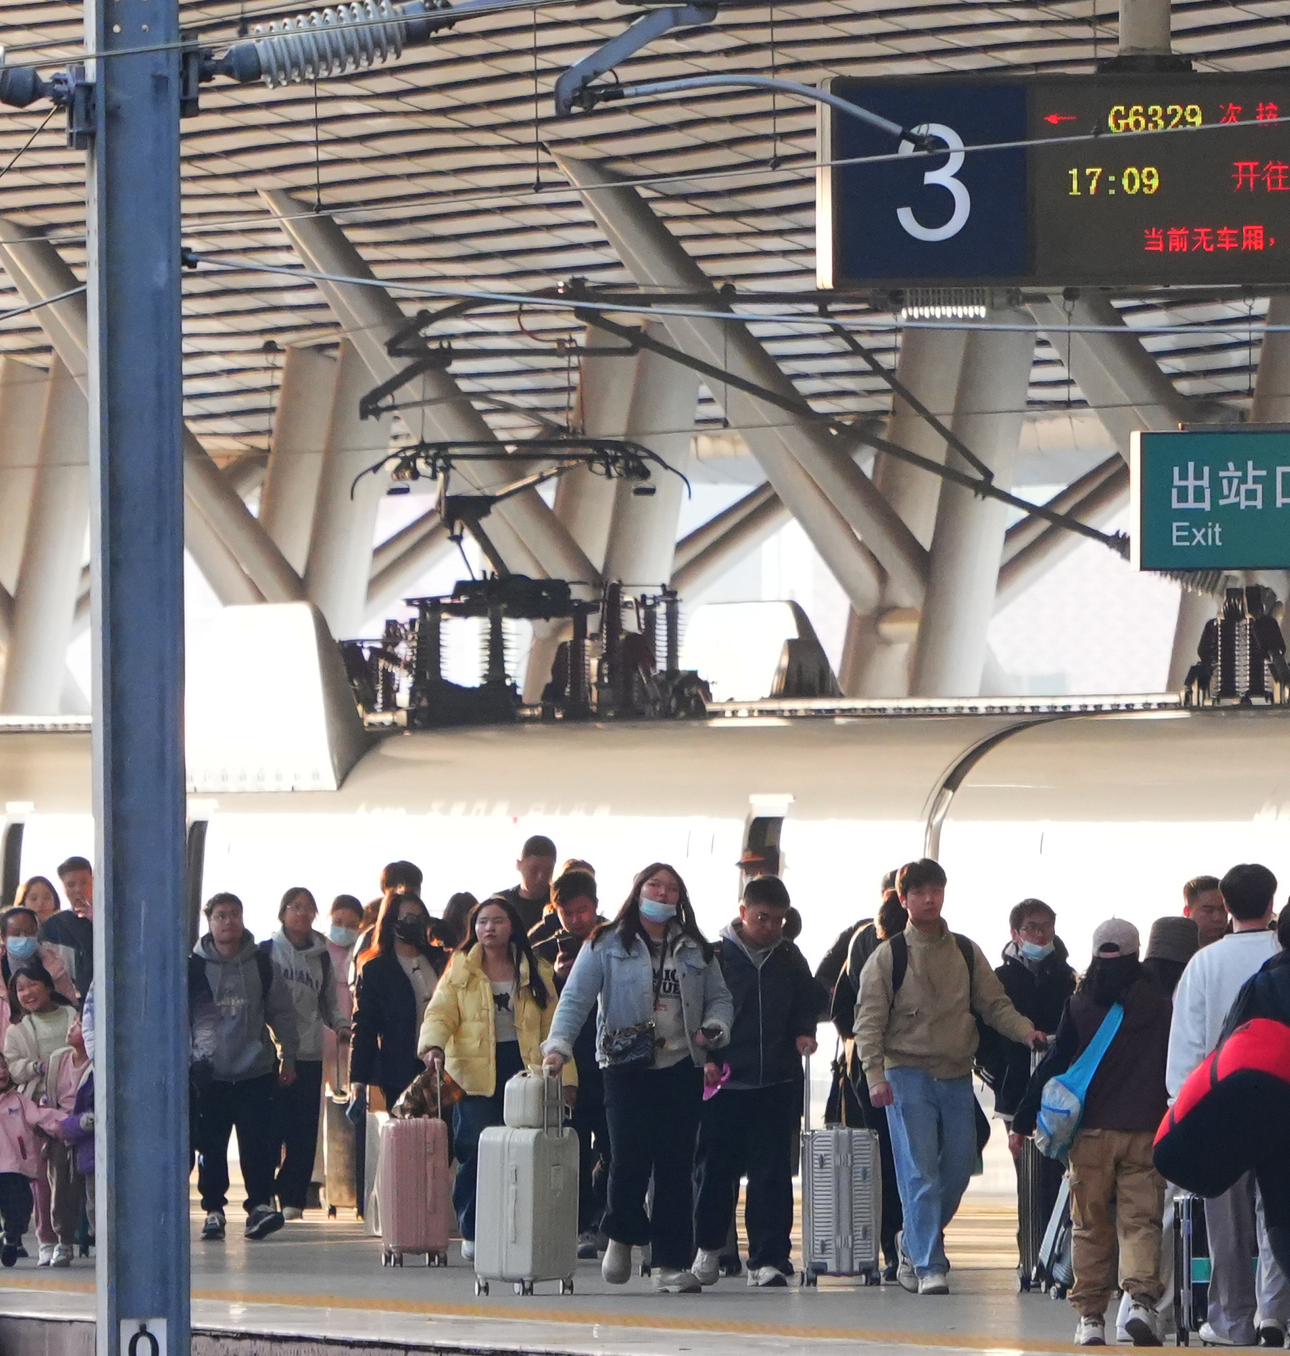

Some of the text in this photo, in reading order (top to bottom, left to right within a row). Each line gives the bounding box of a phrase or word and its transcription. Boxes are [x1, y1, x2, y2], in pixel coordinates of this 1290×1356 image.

[1108, 104, 1203, 134] G6329
[896, 122, 972, 243] 3
[1068, 167, 1160, 196] 17:09
[1171, 521, 1223, 547] Exit
